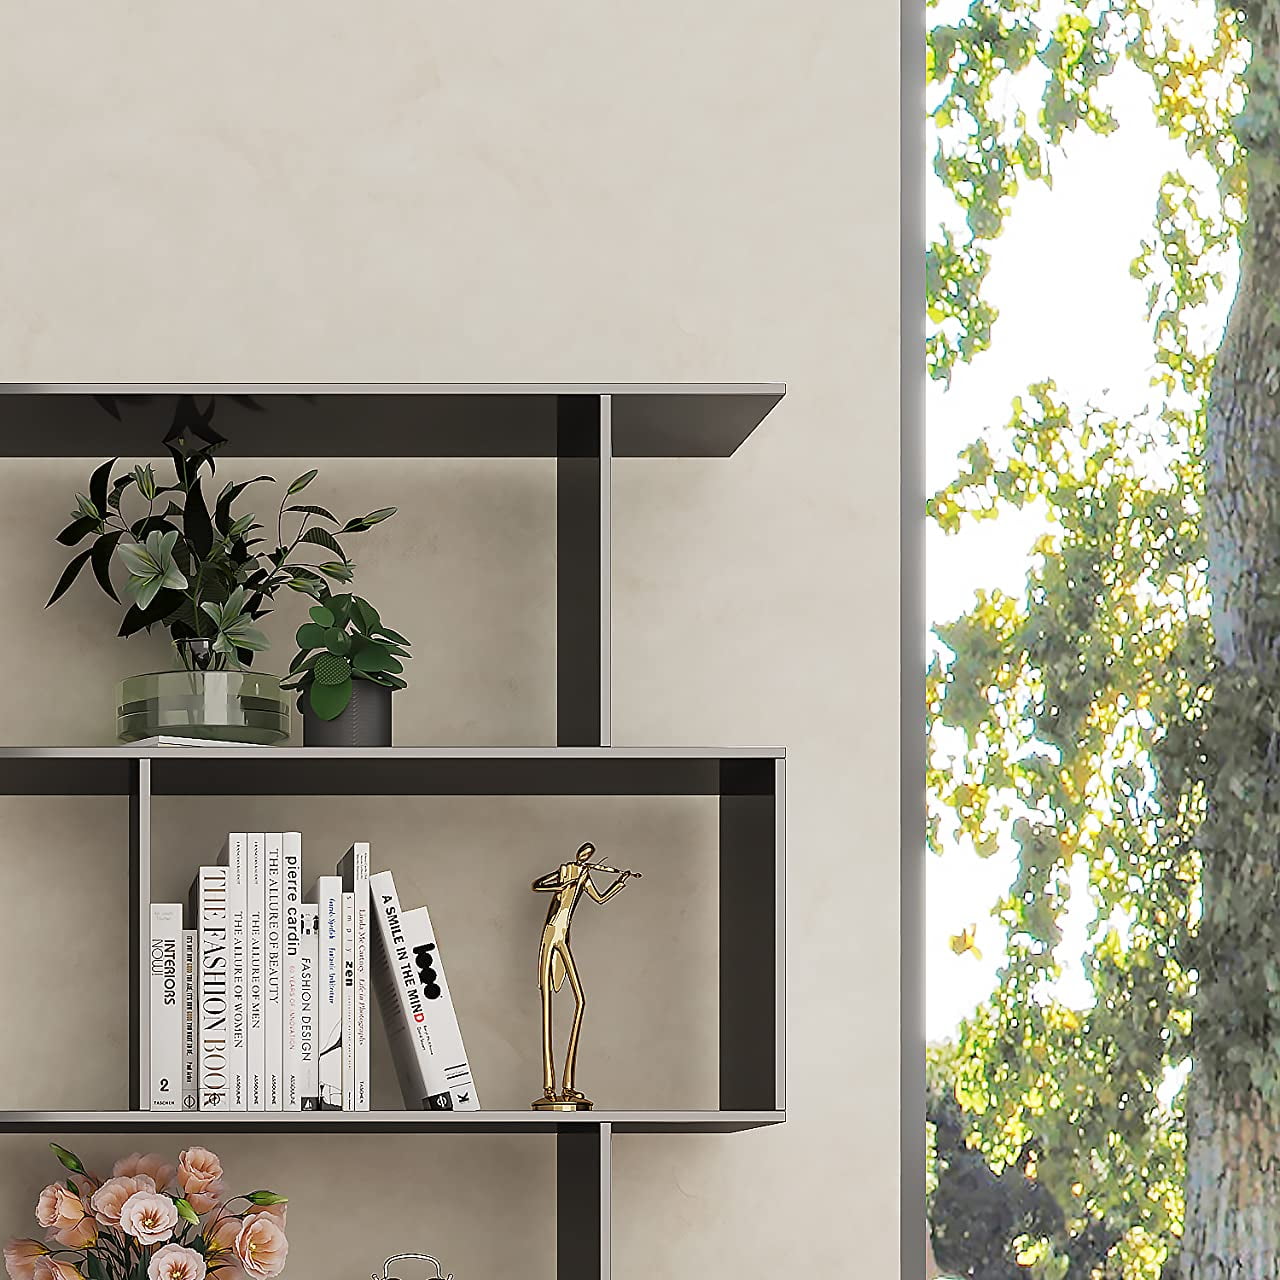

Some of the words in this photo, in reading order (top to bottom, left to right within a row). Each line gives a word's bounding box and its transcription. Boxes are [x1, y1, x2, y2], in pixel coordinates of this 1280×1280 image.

[268, 848, 279, 876] THE
[285, 856, 300, 902] pierre
[203, 869, 227, 921] THE
[268, 876, 279, 930] ALLURE
[381, 895, 392, 905] A
[233, 911, 244, 937] THE
[250, 911, 261, 937] THE
[287, 907, 300, 956] cardin
[358, 909, 366, 930] Linda
[385, 907, 405, 945] SMILE
[151, 939, 164, 976] NOW!
[268, 931, 279, 950] OF
[395, 946, 410, 962] IN
[164, 939, 176, 1005] INTERIORS
[203, 926, 227, 1032] FASHION
[233, 937, 244, 984] ALLURE
[250, 937, 261, 984] ALLURE
[268, 952, 279, 1005] BEAUTY
[345, 960, 354, 987] zen
[399, 963, 417, 988] THE
[233, 985, 244, 1002] OF
[250, 985, 261, 1001] OF
[301, 957, 312, 1012] FASHION
[250, 1002, 261, 1030] MEN
[407, 989, 425, 1023] MIND
[233, 1002, 244, 1049] WOMEN
[301, 1016, 312, 1062] DESIGN
[159, 1078, 170, 1092] 2
[203, 1038, 227, 1108] BOOK
